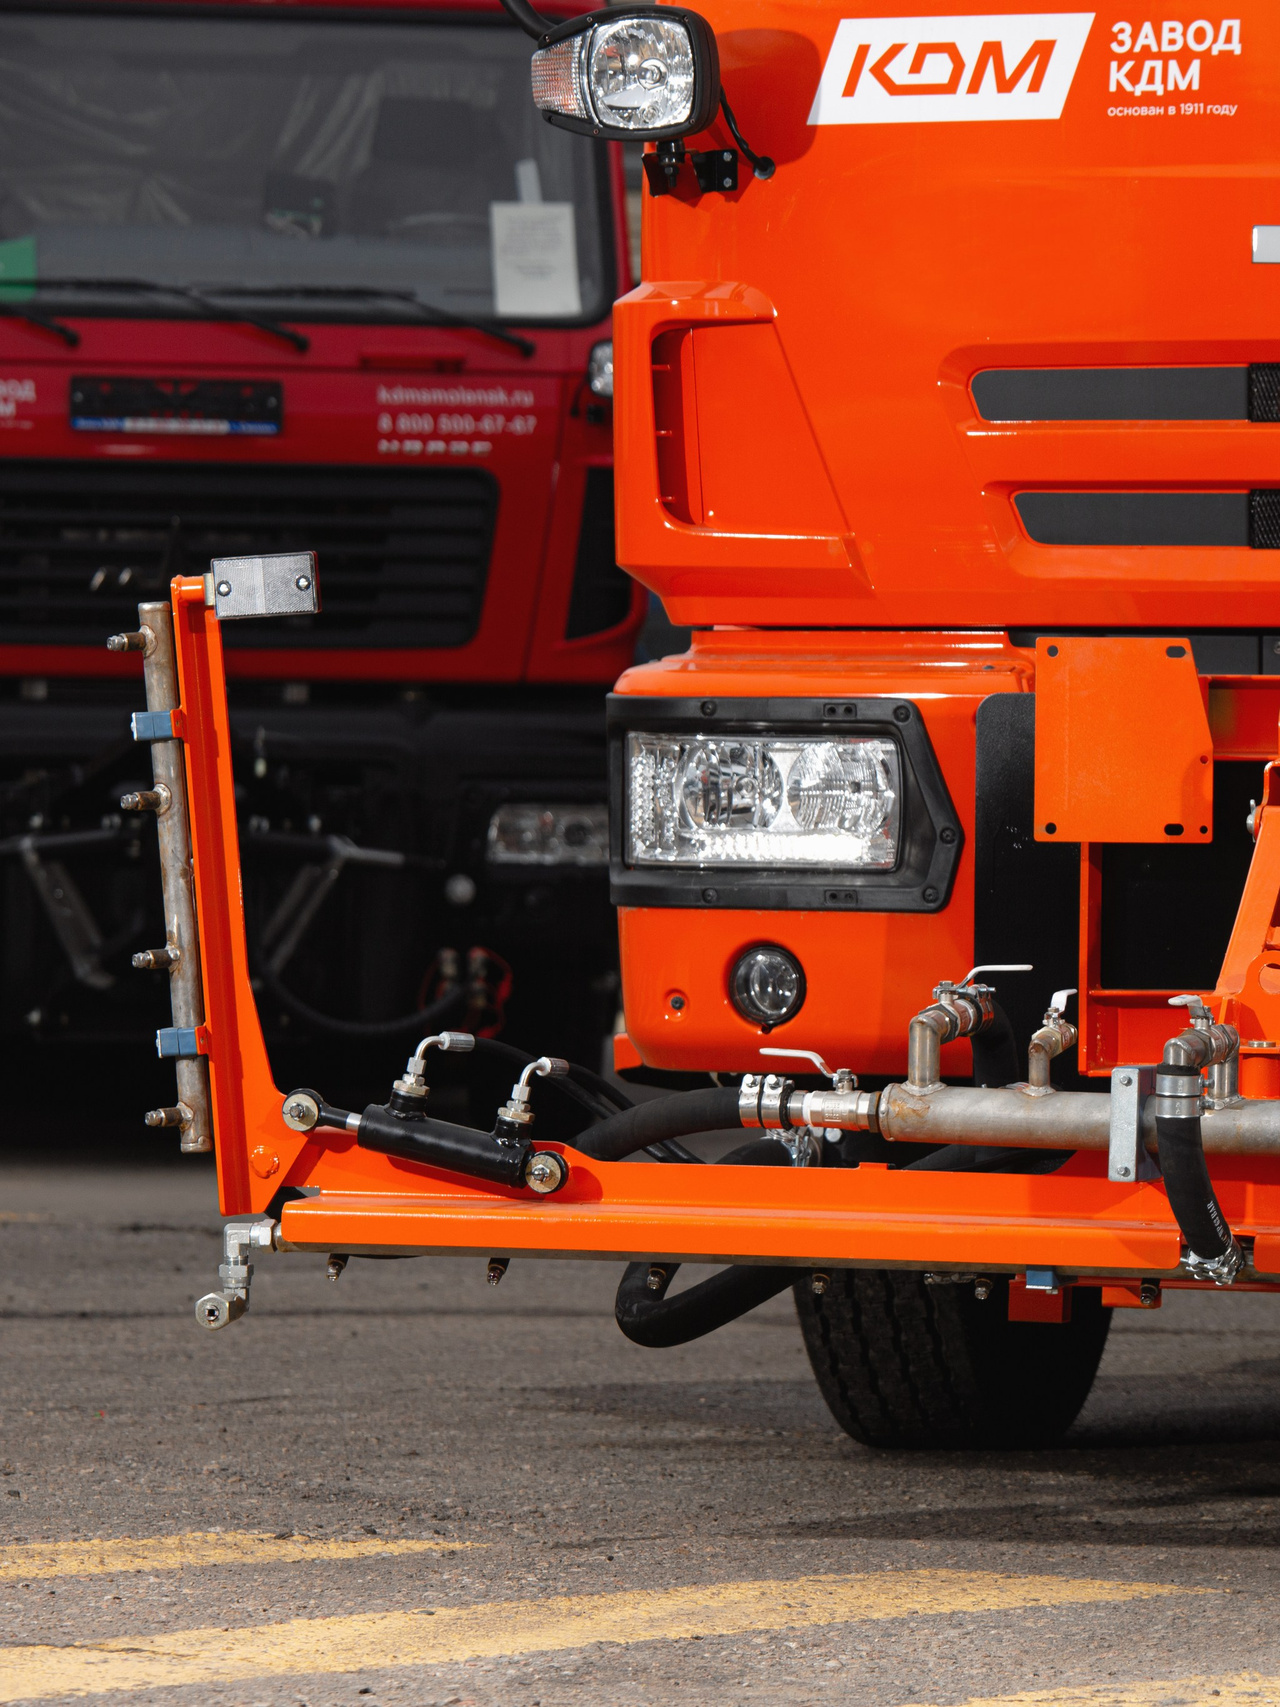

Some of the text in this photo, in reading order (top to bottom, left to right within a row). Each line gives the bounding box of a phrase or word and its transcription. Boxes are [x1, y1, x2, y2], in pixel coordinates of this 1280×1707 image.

[1110, 19, 1242, 55] ЗАВОД
[1109, 59, 1201, 96] КДМ
[1107, 102, 1238, 117] основан в 1911 году
[377, 412, 393, 434] 8
[1206, 1200, 1218, 1219] BAR
